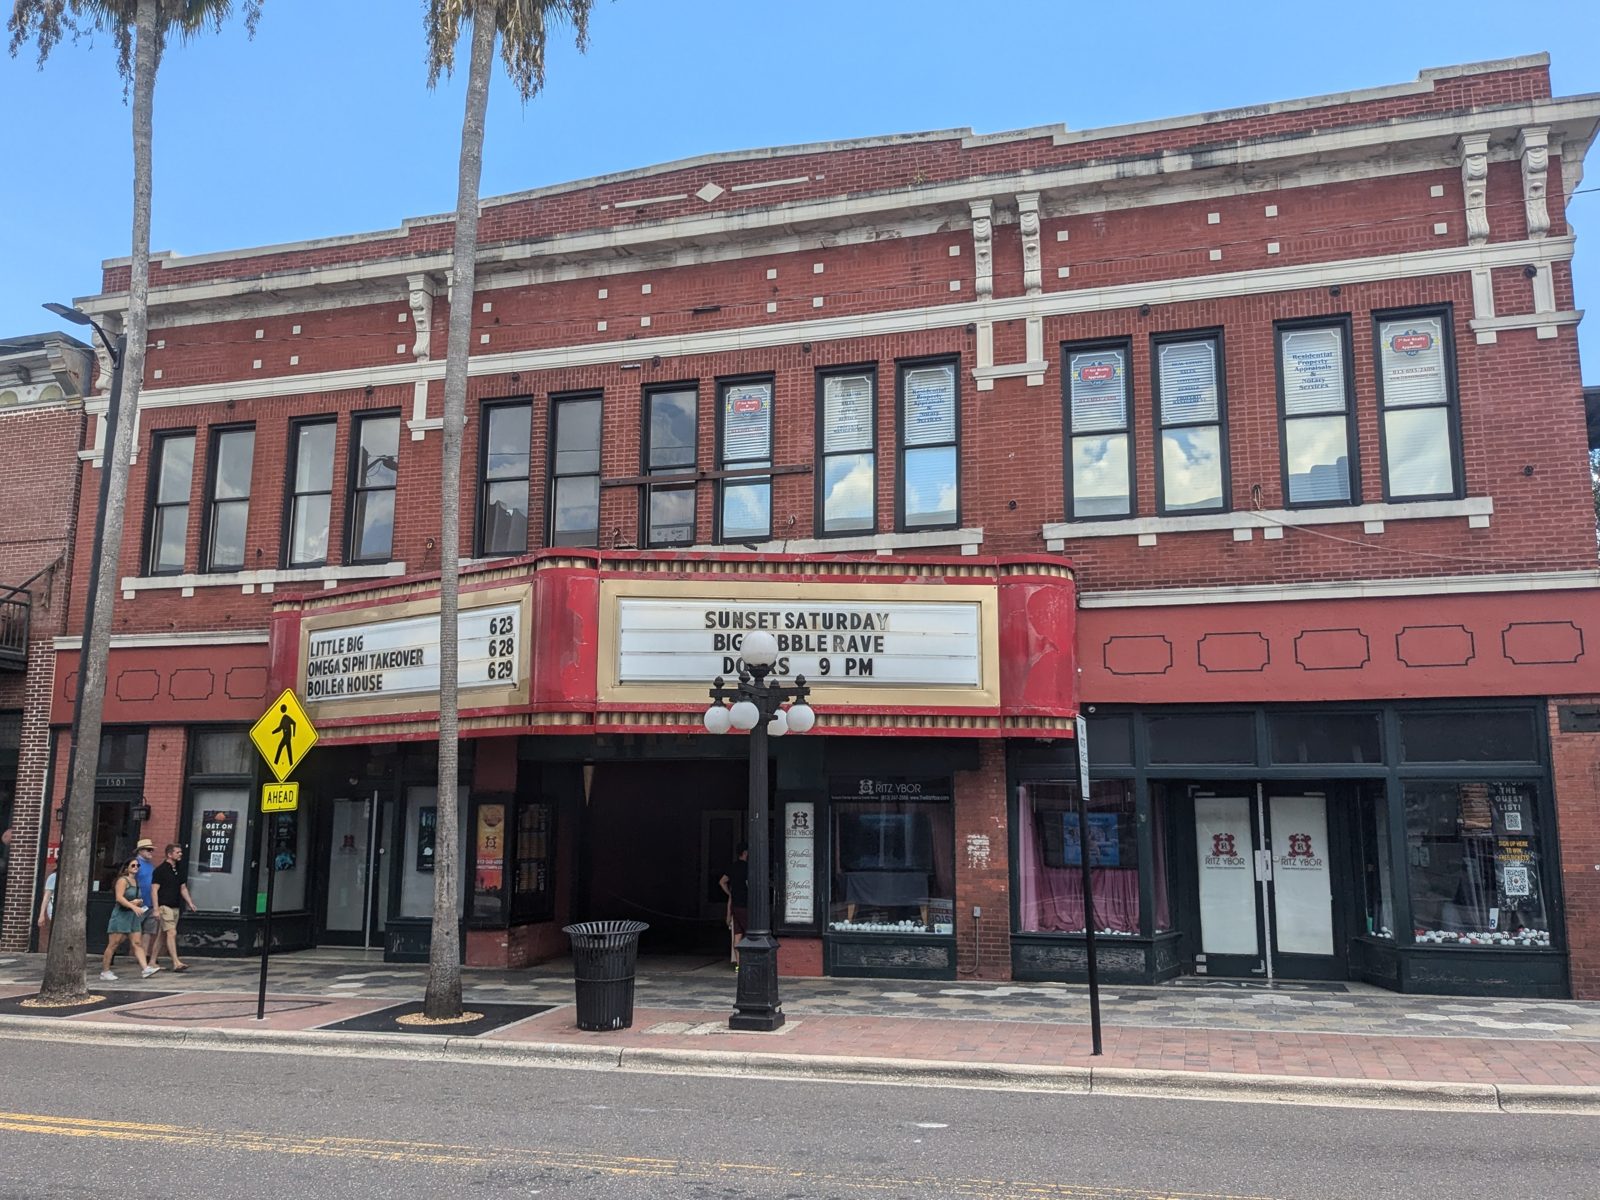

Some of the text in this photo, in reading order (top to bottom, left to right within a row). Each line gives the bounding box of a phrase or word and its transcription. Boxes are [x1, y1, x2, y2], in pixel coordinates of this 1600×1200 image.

[1295, 365, 1332, 373] Appraisals
[490, 615, 513, 635] 6 23
[705, 611, 889, 631] SUNSET SATURDAY
[310, 635, 364, 657] LITTLE BIG
[488, 638, 514, 657] 6 28
[714, 633, 743, 652] BIG
[833, 635, 884, 653] RAVE
[308, 659, 340, 677] OMEGA
[352, 654, 368, 672] PHI
[369, 648, 424, 670] TAKEOVER
[487, 660, 513, 680] 6 29
[819, 657, 831, 676] 9
[845, 658, 873, 676] PM
[308, 674, 383, 697] BOILER HOUSE
[267, 790, 294, 804] AHEAD
[875, 783, 921, 793] RITZ YBOR
[1205, 857, 1245, 865] RITZ YBOR
[1281, 858, 1322, 866] RITZ YBOR
